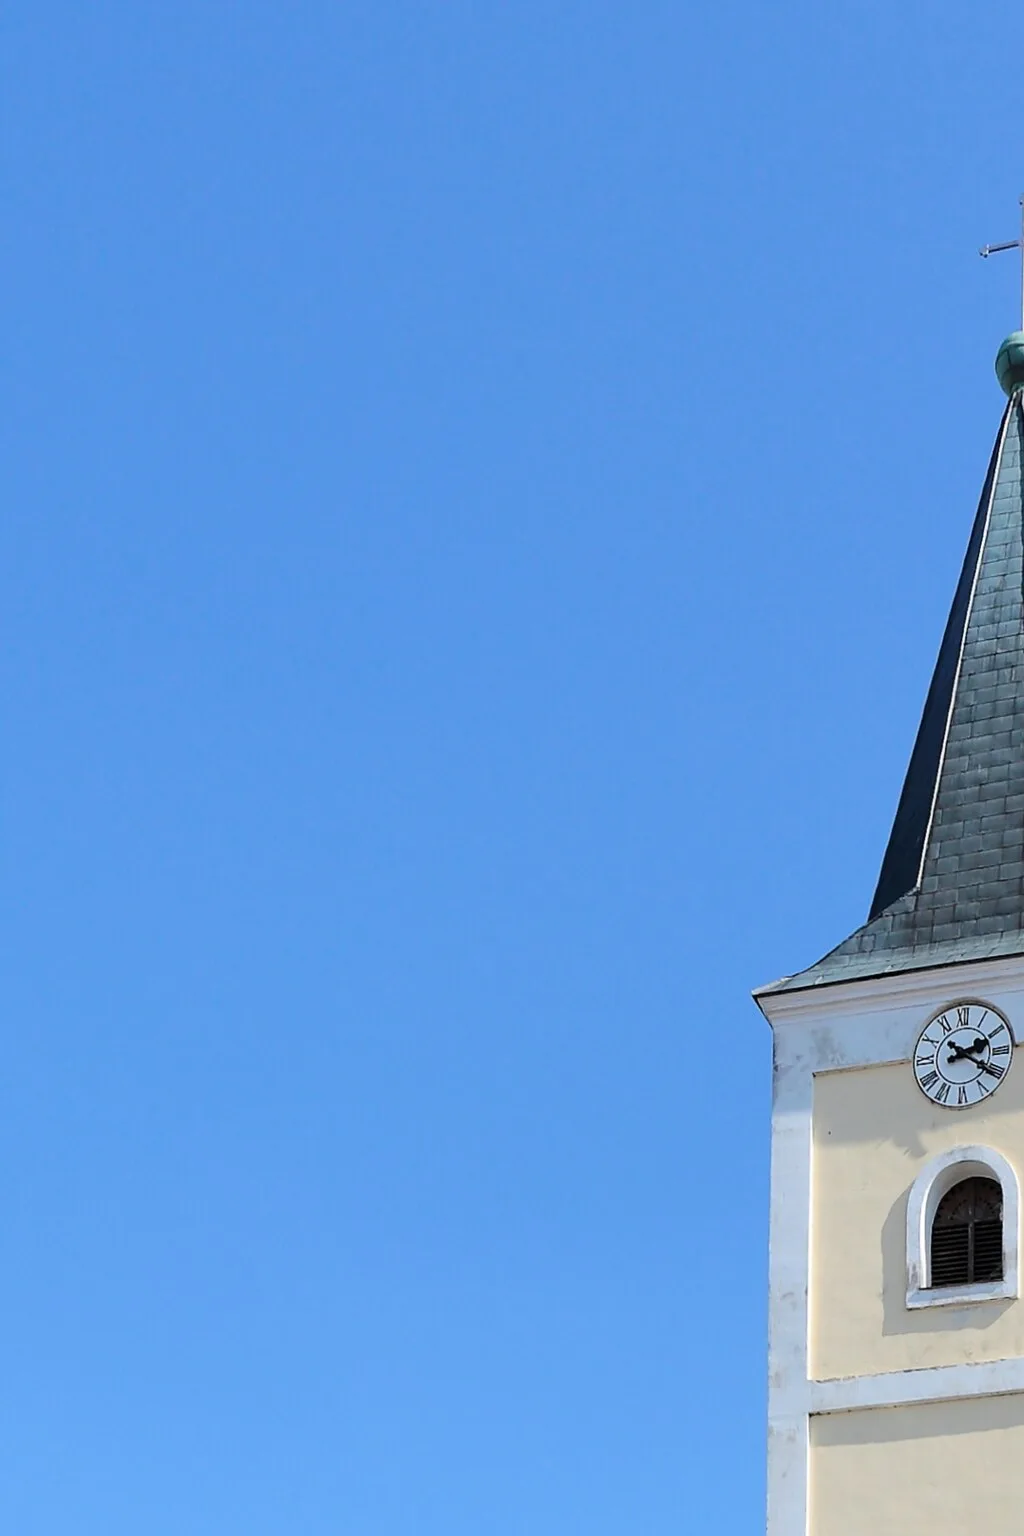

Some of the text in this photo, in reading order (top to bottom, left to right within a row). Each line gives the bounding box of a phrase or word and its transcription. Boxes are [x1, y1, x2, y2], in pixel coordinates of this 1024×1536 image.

[937, 1015, 952, 1035] XI
[956, 1007, 969, 1028] XII
[977, 1011, 988, 1028] I
[988, 1024, 1004, 1039] II
[922, 1034, 939, 1048] X
[992, 1045, 1009, 1056] III
[917, 1054, 934, 1066] IX
[920, 1070, 939, 1092] VIII
[976, 1080, 989, 1096] V
[934, 1082, 951, 1103] VII
[957, 1086, 968, 1104] VI
